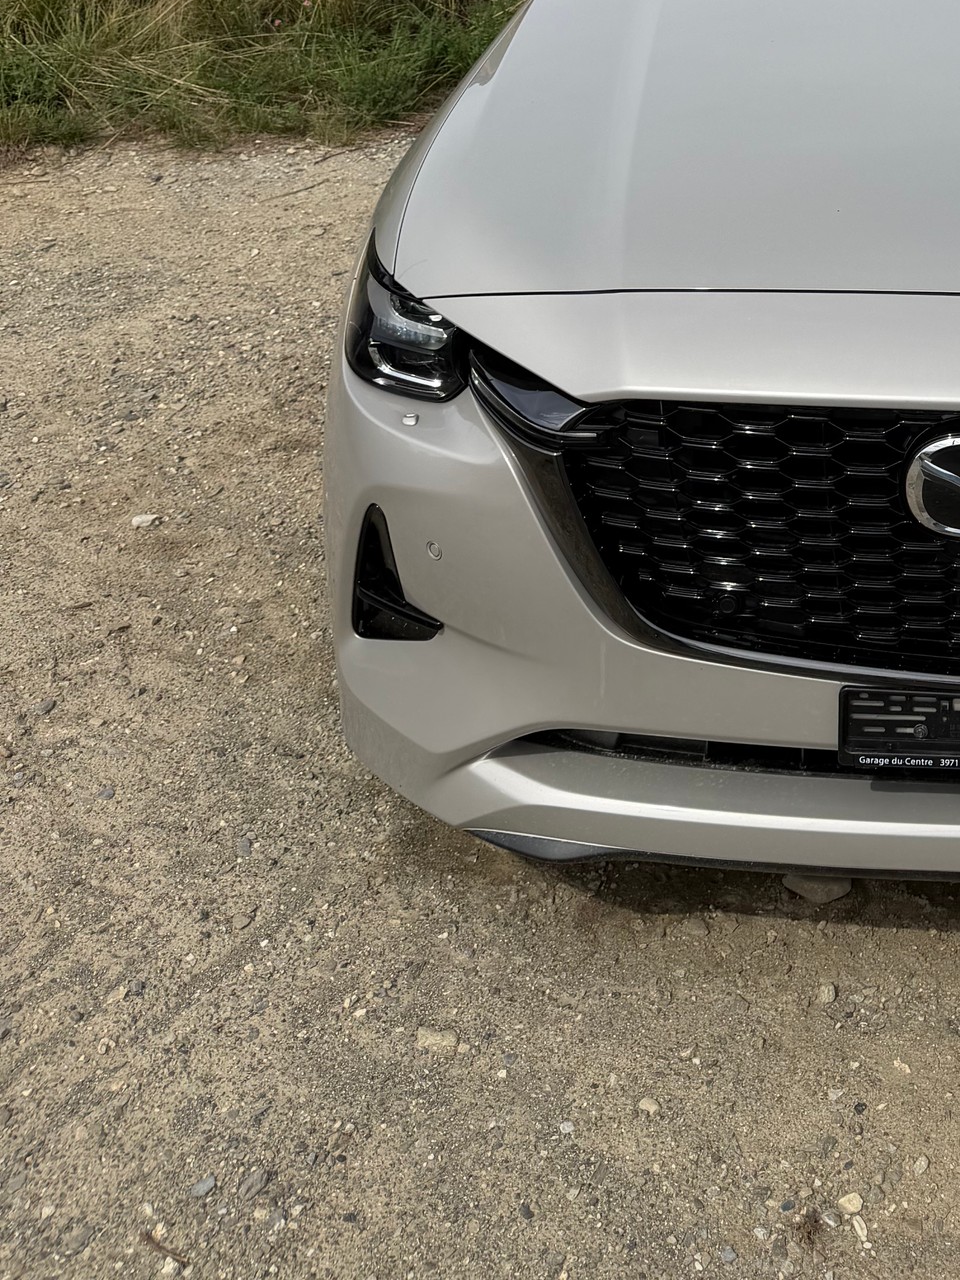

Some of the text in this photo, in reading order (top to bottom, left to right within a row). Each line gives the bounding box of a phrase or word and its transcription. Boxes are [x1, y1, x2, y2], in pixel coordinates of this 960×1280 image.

[859, 756, 890, 766] Garage
[891, 757, 903, 765] du
[904, 757, 934, 766] Centre
[939, 758, 959, 767] 3971
